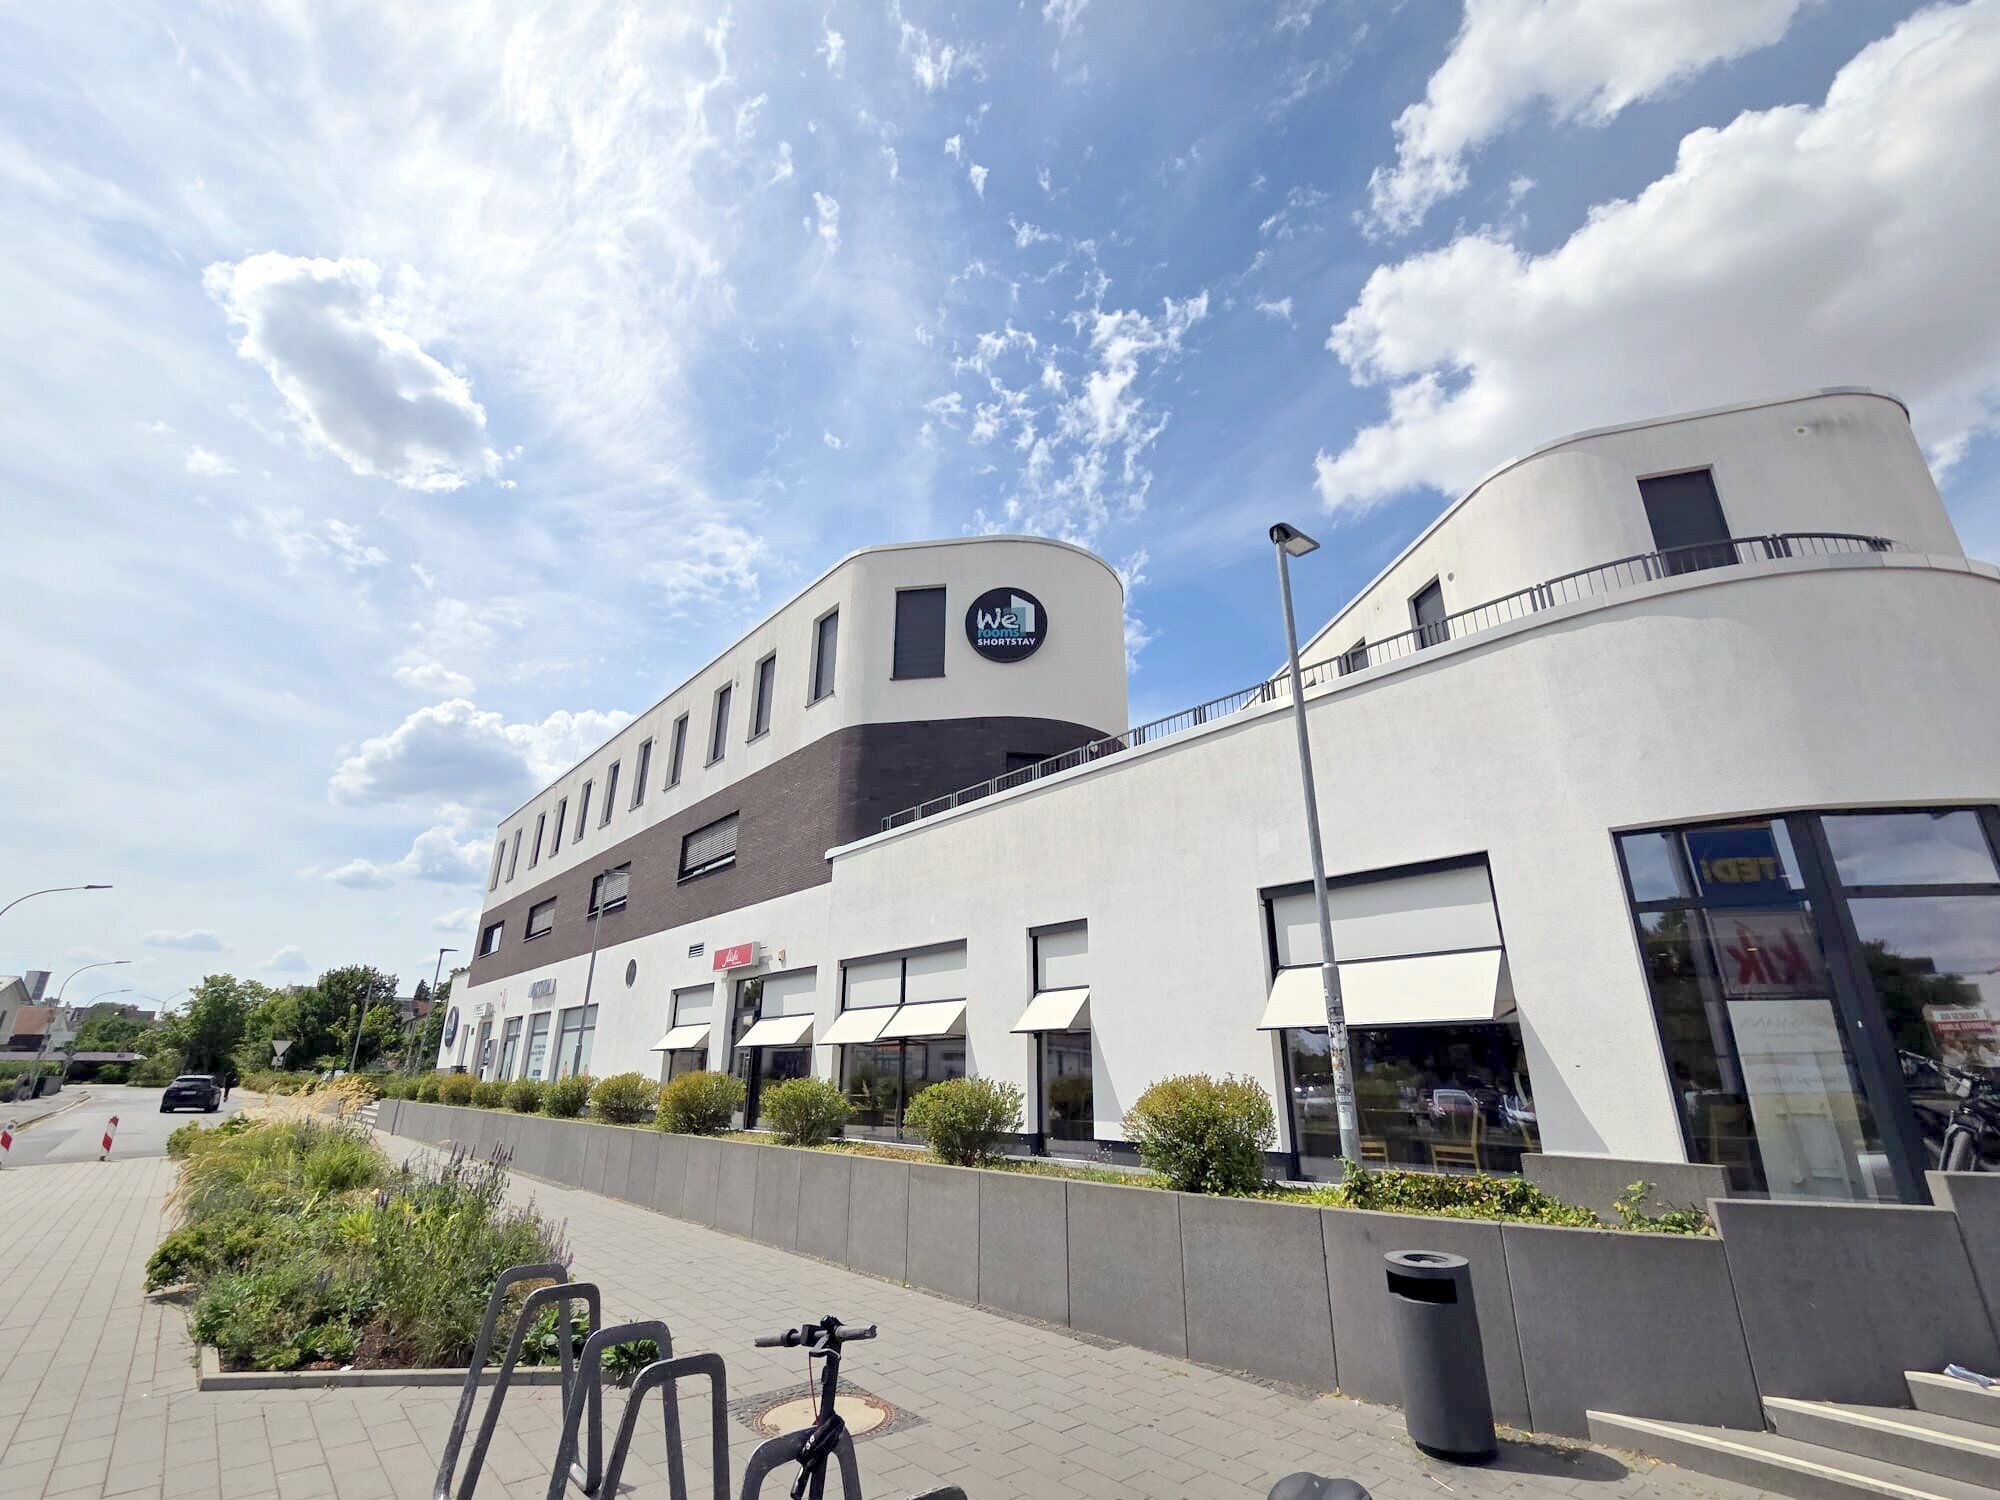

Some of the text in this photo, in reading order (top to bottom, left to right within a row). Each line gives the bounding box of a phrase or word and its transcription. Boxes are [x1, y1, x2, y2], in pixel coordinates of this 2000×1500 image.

[977, 608, 1019, 629] We
[977, 629, 1020, 637] rooms
[977, 638, 1036, 646] SHORTSTAY
